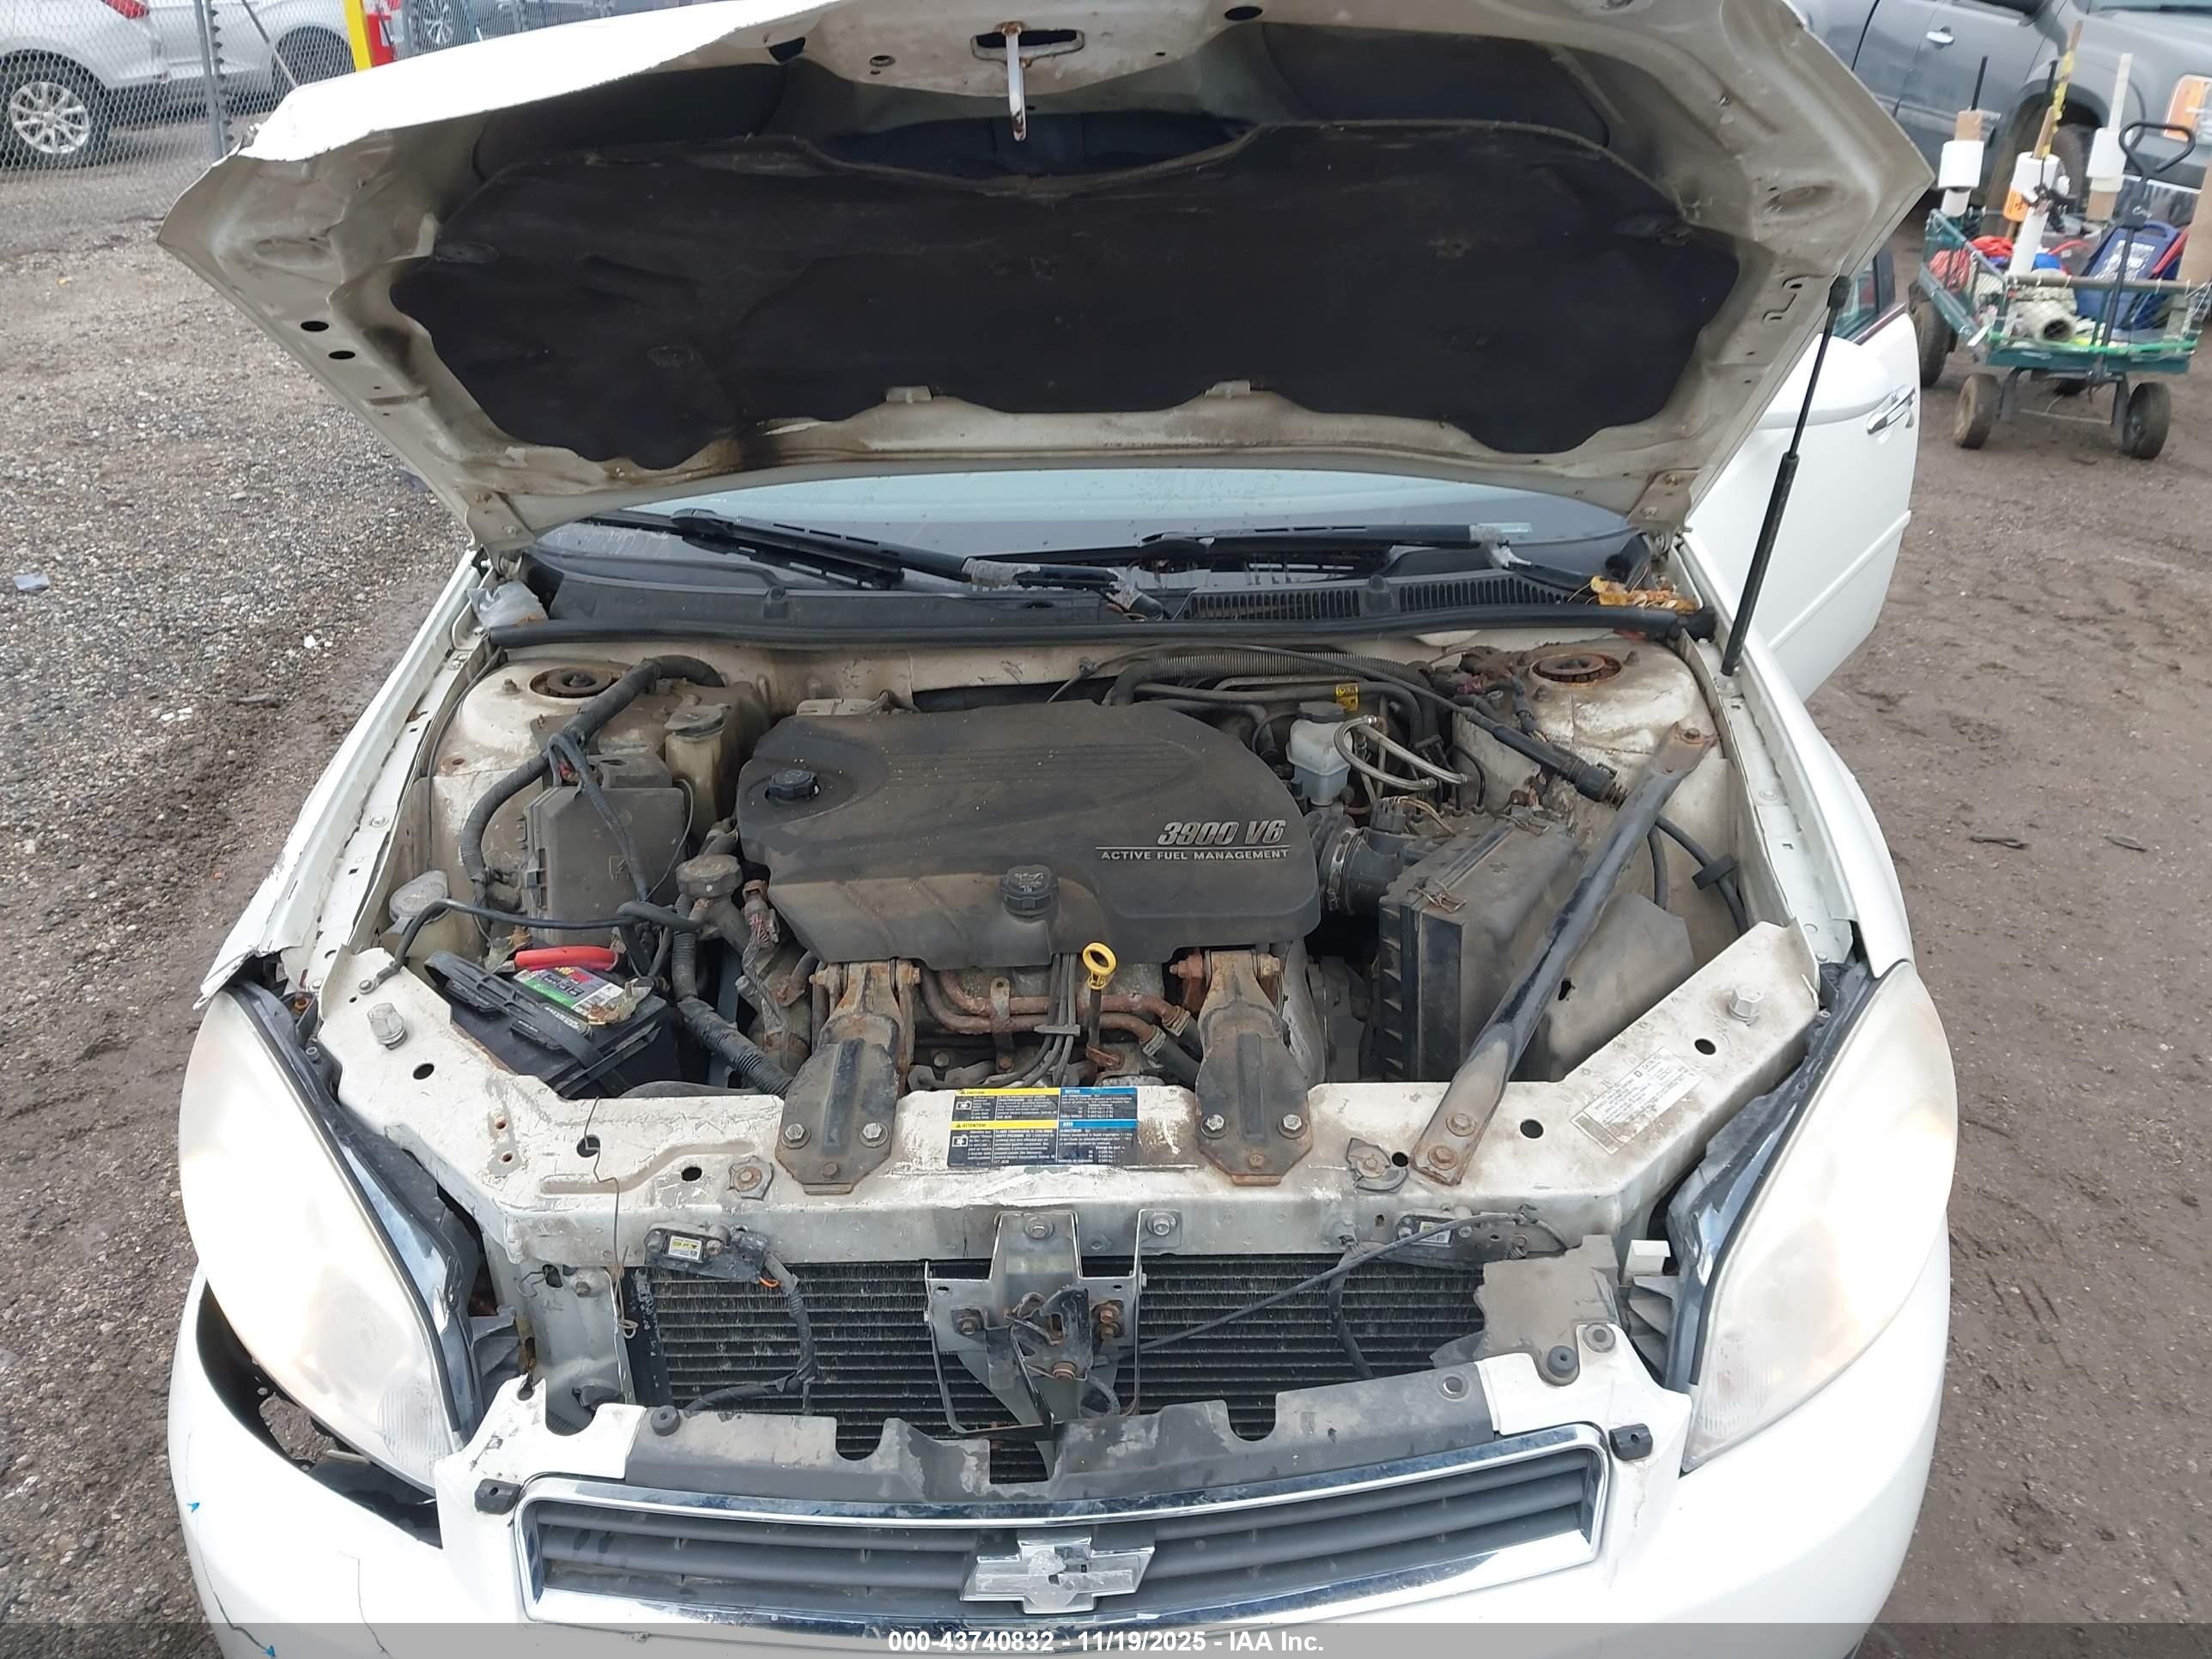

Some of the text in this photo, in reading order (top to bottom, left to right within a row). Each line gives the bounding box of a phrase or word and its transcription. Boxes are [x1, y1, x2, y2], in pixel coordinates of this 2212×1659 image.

[1157, 819, 1287, 847] 3900 V6
[1101, 849, 1290, 860] ACTIVE FUEL MANAGEMENT
